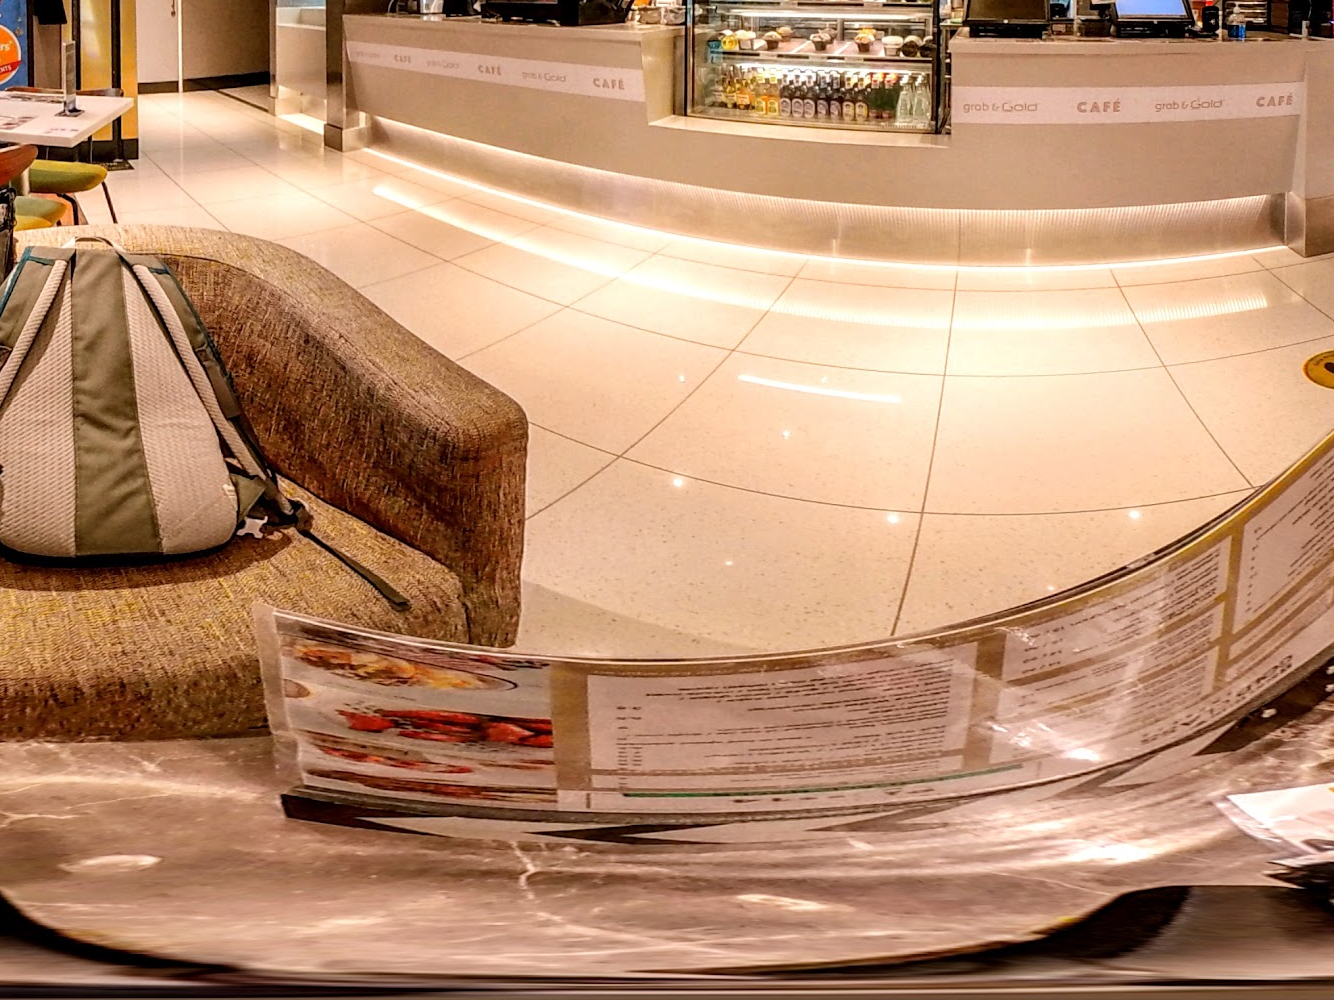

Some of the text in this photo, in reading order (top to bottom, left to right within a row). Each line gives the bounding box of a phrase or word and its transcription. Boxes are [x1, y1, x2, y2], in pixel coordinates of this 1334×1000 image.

[478, 64, 502, 76] CAFÉ
[544, 72, 567, 83] Gold
[593, 77, 625, 91] CAFÉ
[963, 92, 1294, 114] grab & Gold CAFÉ grab & Gold CAFÉ
